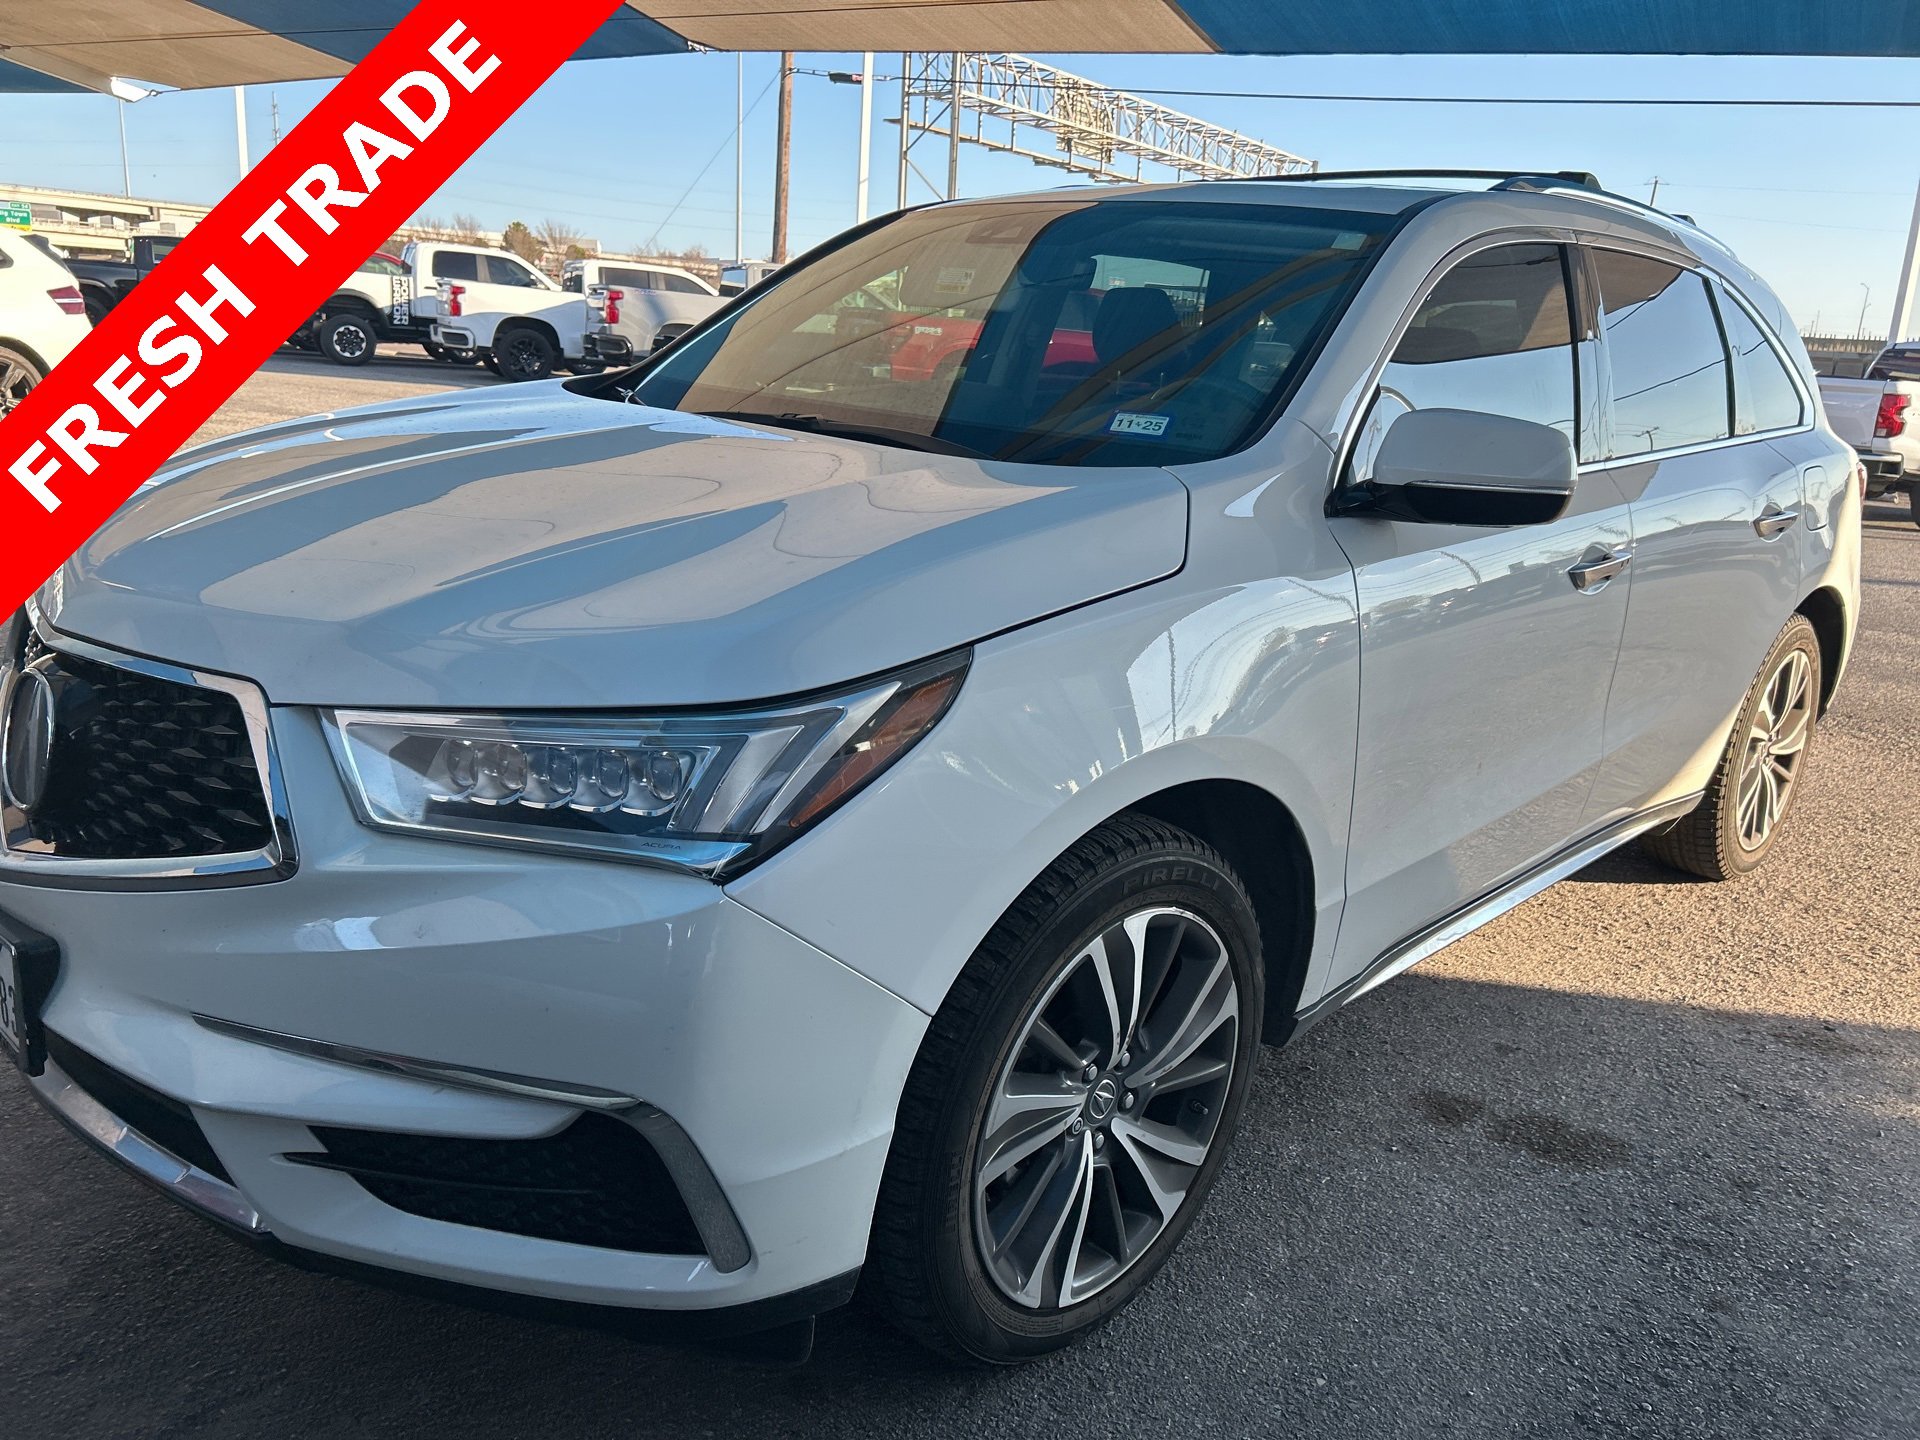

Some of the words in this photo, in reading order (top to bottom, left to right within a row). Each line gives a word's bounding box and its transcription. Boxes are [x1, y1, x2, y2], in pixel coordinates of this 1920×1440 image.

[393, 276, 401, 325] WAGON
[401, 276, 409, 325] POWER
[641, 842, 681, 850] ACURA
[1122, 865, 1220, 895] PIRELLI
